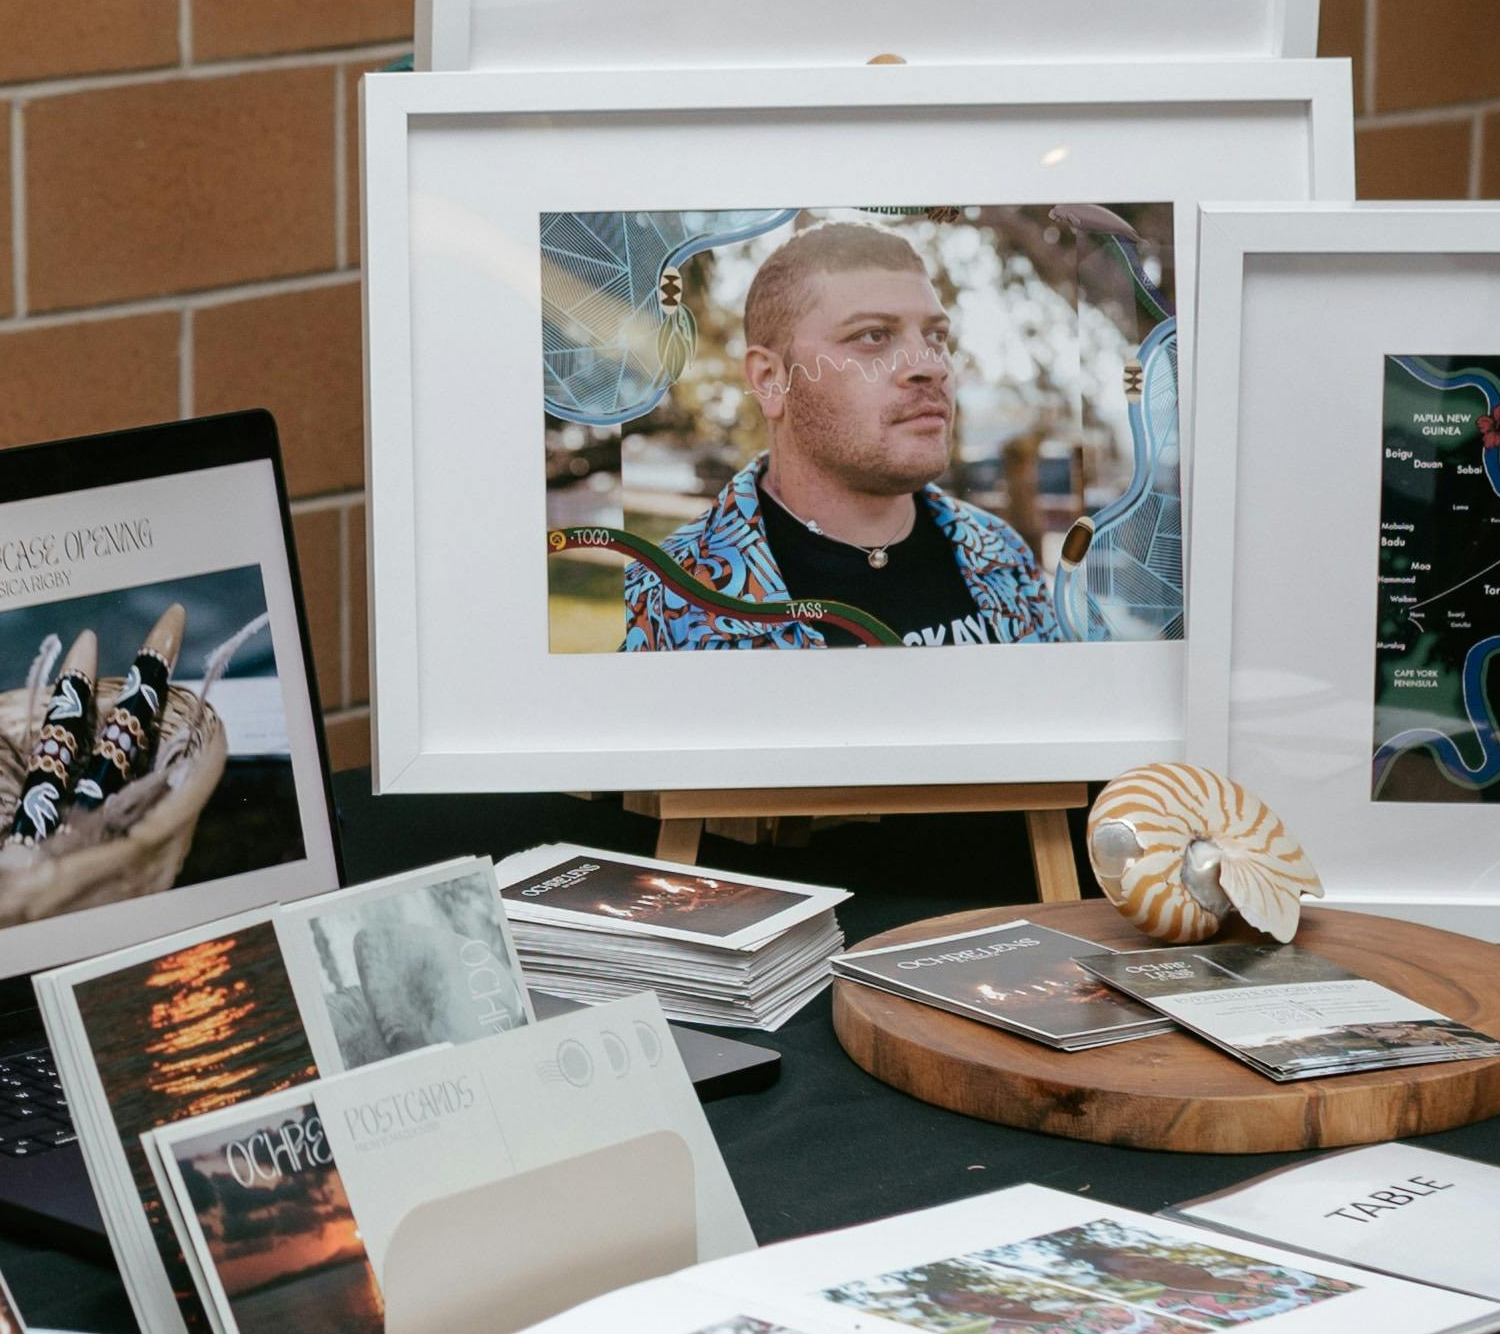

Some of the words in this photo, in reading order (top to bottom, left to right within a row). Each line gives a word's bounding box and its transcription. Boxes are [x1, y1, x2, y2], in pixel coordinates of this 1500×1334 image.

[1413, 413, 1444, 424] PAPUA
[1446, 413, 1471, 423] NEW
[1422, 425, 1462, 436] GUINEA
[1385, 448, 1413, 461] Boigu
[1413, 458, 1443, 469] Dauan
[64, 517, 154, 563] OPENING
[1381, 536, 1406, 547] Badu
[1410, 561, 1432, 571] Moa
[31, 569, 74, 594] RIGBY
[1394, 669, 1413, 678] CAPE
[1415, 669, 1438, 678] YORK
[1394, 680, 1438, 688] PENINSULA
[343, 1075, 475, 1142] POSTCARDS
[1323, 1175, 1456, 1224] TABLE
